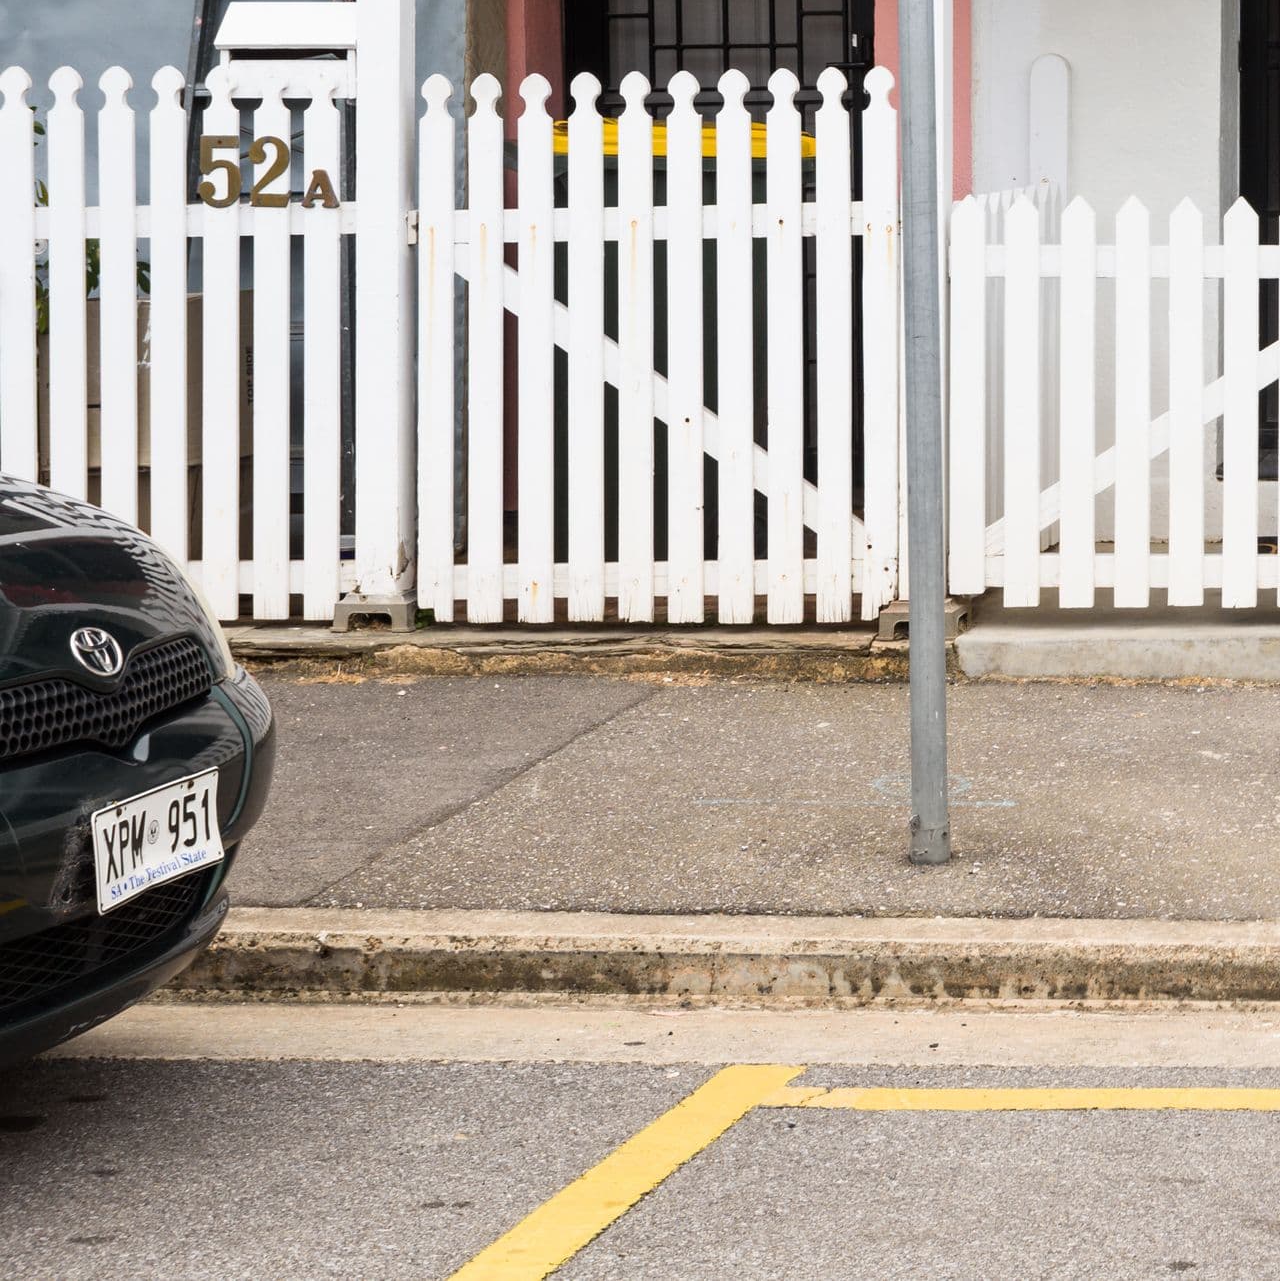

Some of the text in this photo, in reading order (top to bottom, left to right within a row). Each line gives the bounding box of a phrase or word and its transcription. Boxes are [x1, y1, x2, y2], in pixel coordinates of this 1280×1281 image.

[103, 788, 210, 884] XPM 951
[111, 849, 207, 900] SA The Festival State
